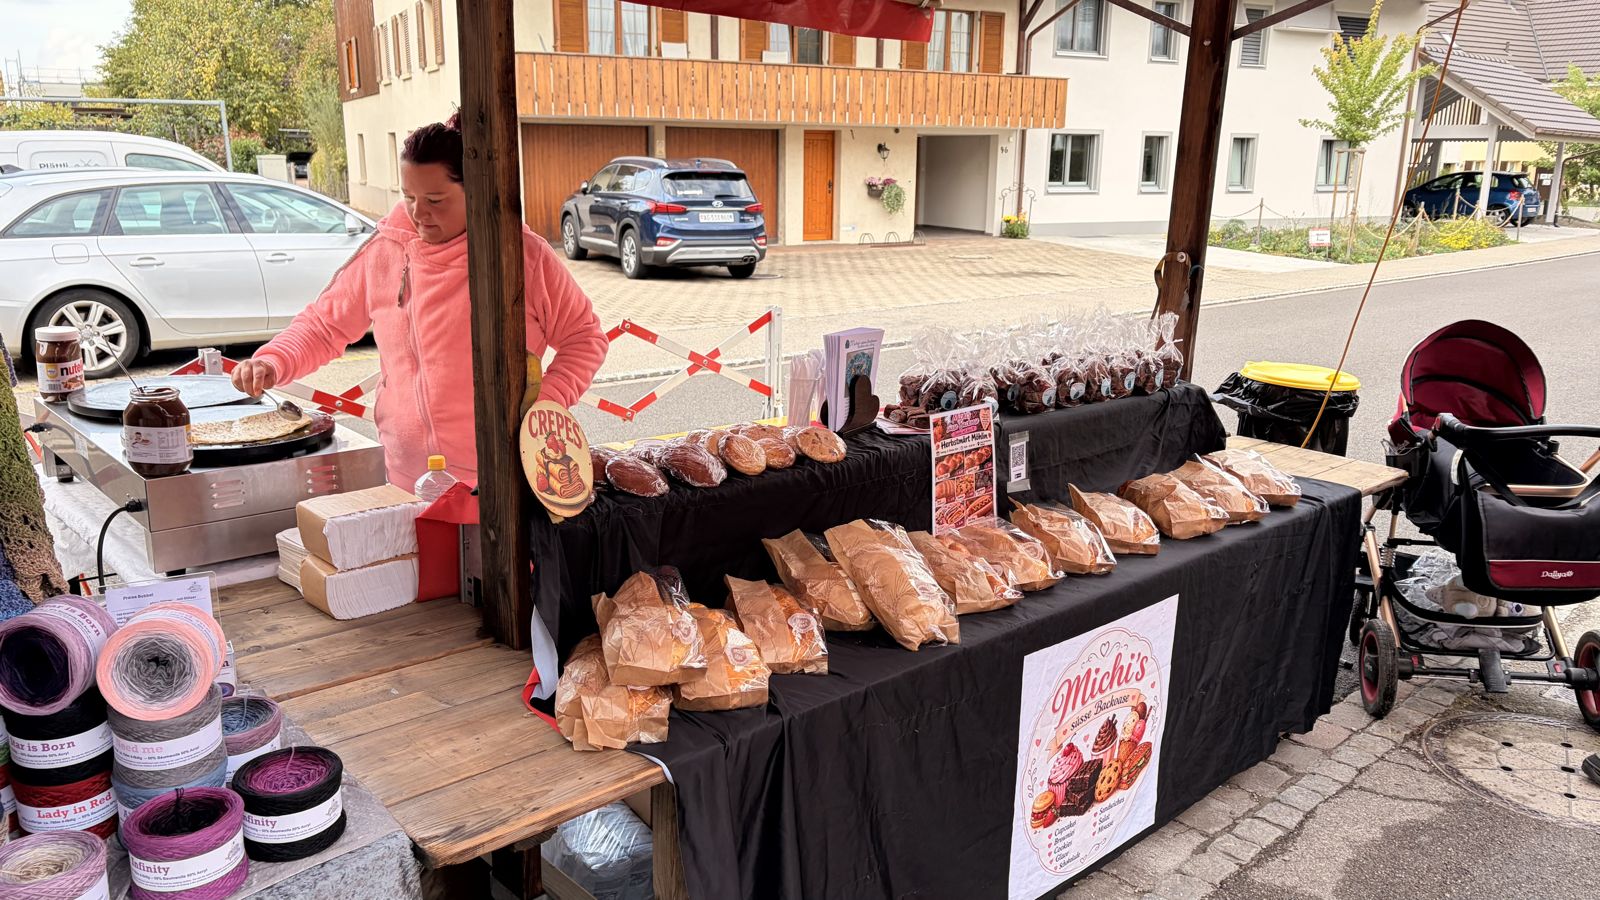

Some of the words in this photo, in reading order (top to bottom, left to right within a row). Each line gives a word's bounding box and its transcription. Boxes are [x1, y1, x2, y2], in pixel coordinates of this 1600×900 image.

[528, 409, 582, 449] CREPES
[79, 612, 101, 637] Born
[1052, 652, 1149, 730] Michi's
[1071, 710, 1092, 731] süsse
[1094, 694, 1131, 716] Backoase
[11, 740, 25, 751] tar
[28, 742, 38, 752] is
[41, 740, 76, 752] Born
[142, 746, 164, 754] me
[36, 809, 69, 819] Lady
[73, 805, 87, 815] in
[89, 792, 112, 809] Red
[243, 814, 277, 829] nfinity
